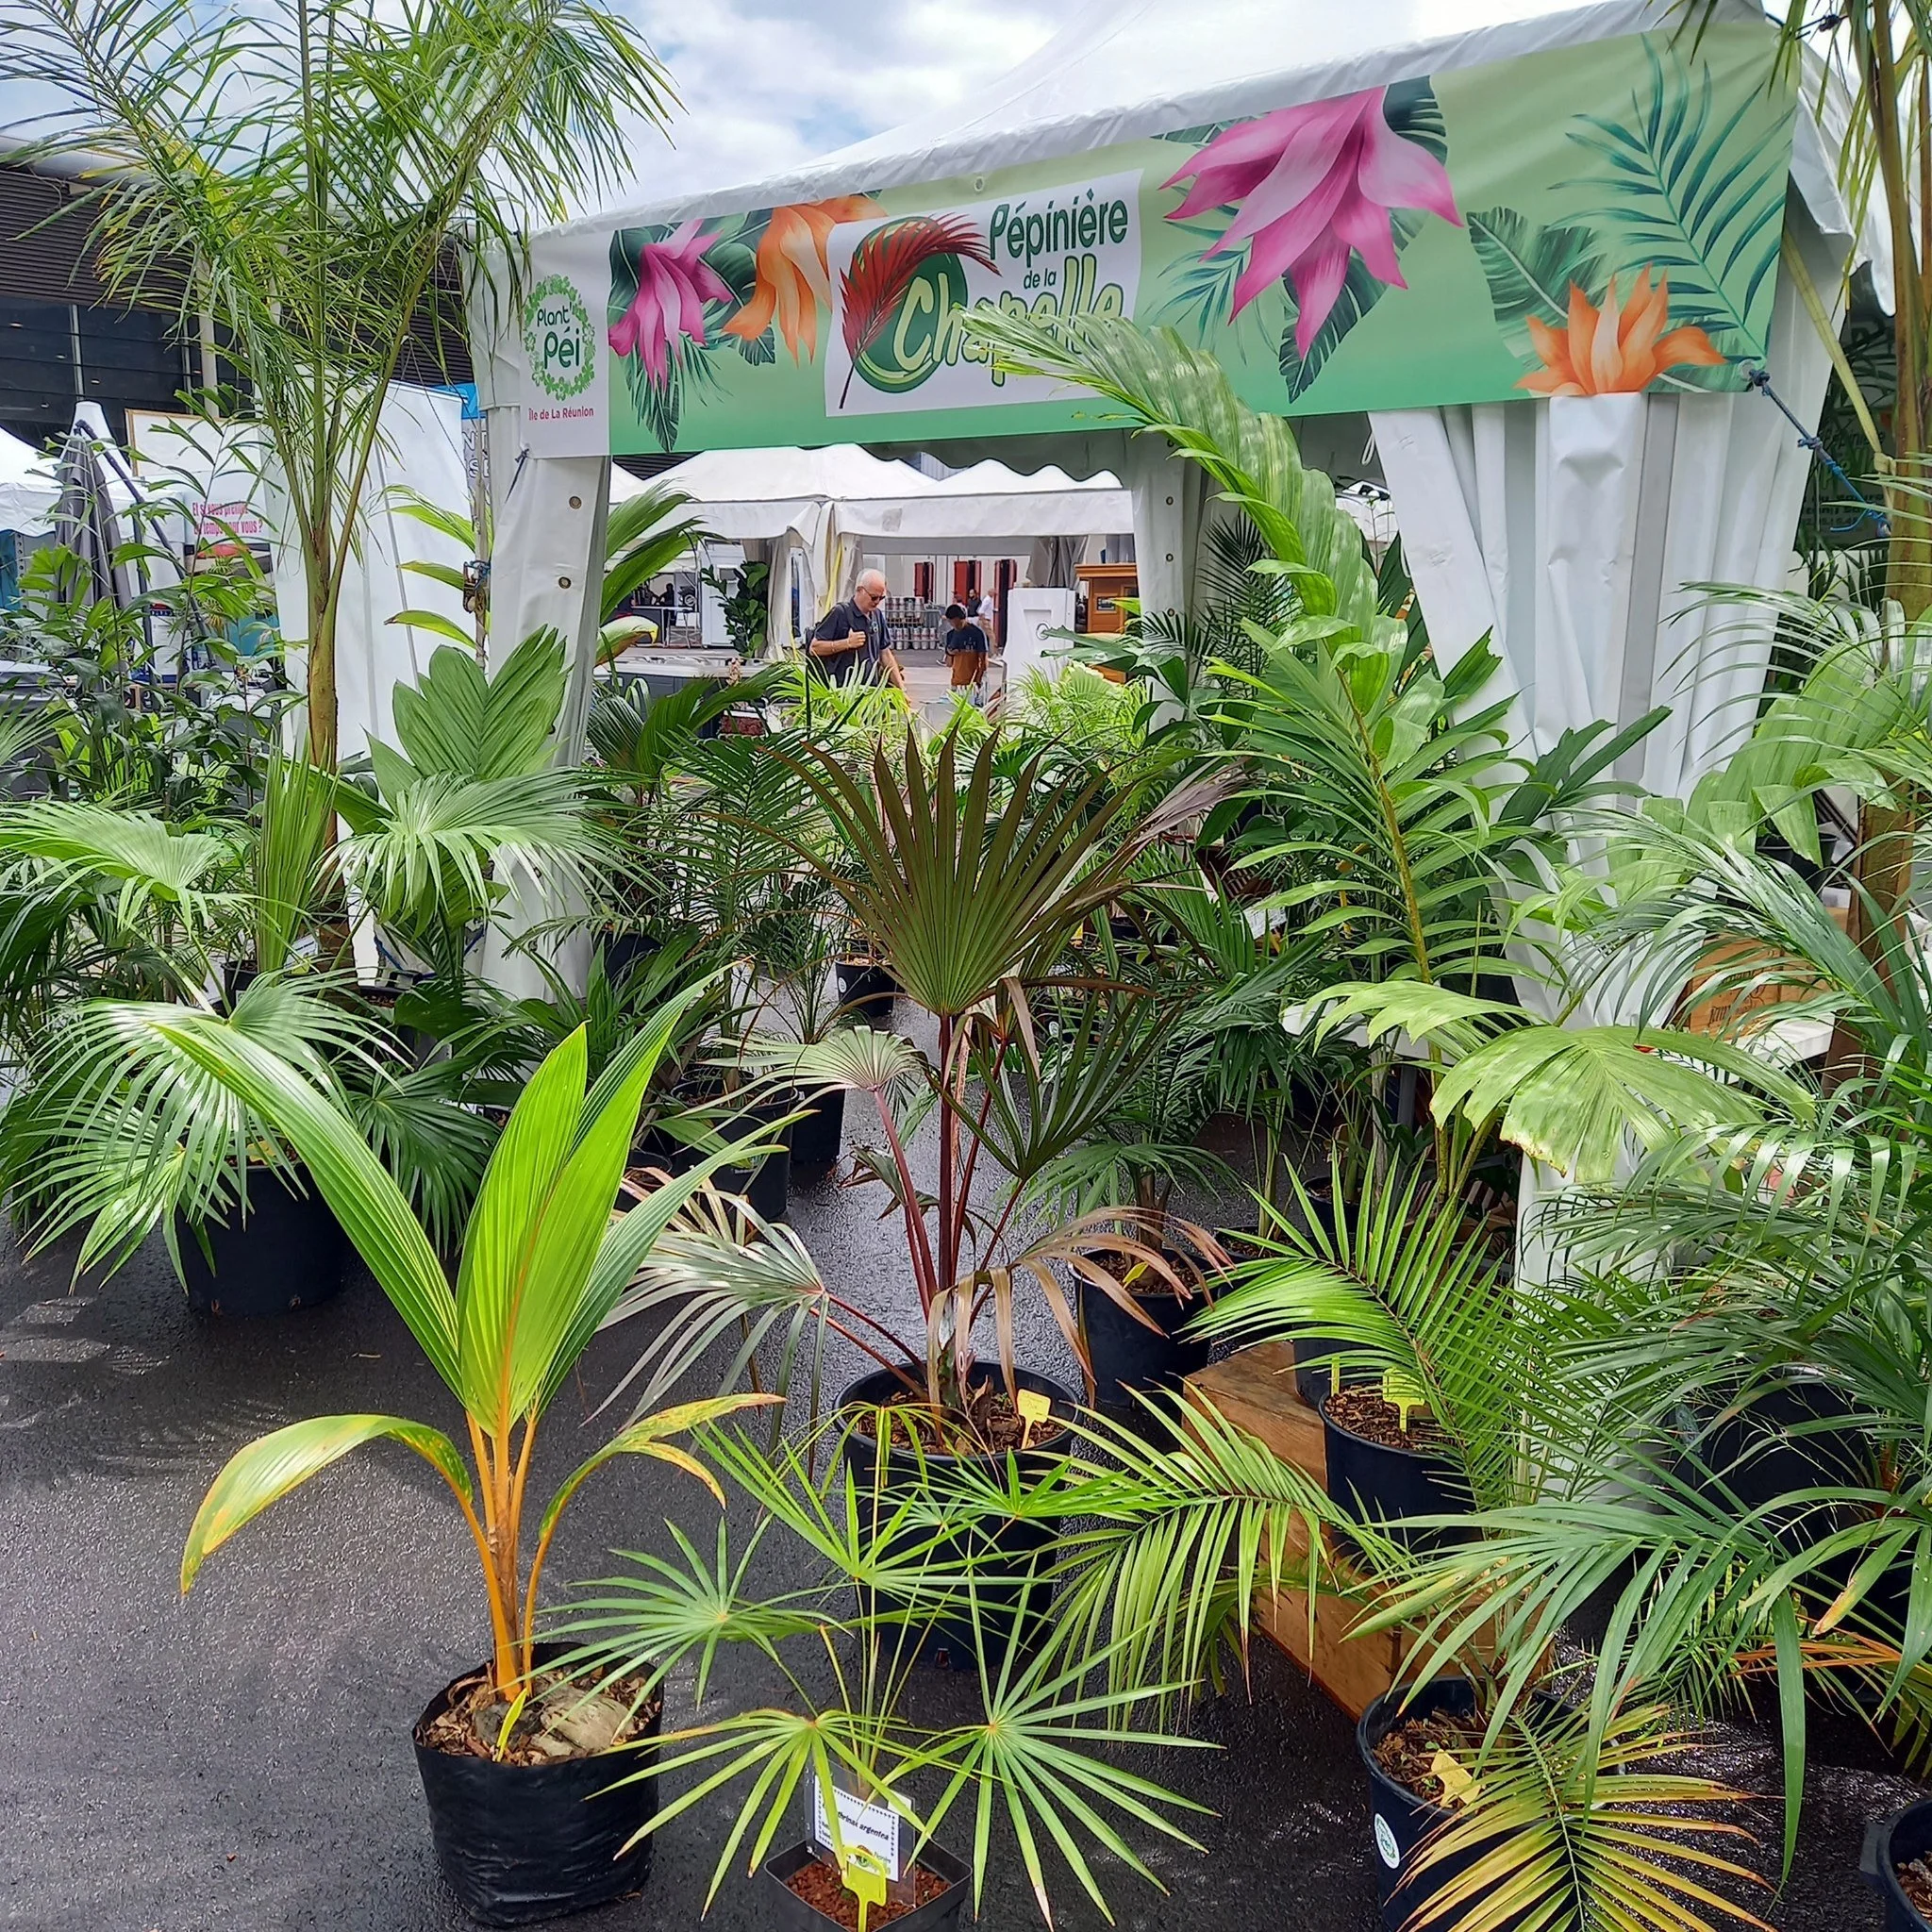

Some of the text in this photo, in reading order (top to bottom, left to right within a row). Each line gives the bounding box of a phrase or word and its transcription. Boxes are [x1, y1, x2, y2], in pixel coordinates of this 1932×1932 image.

[990, 188, 1128, 268] Pépinière
[1023, 267, 1058, 290] de la
[543, 325, 580, 370] Péi
[540, 408, 550, 420] de
[551, 408, 560, 419] La
[562, 406, 594, 419] Réunion
